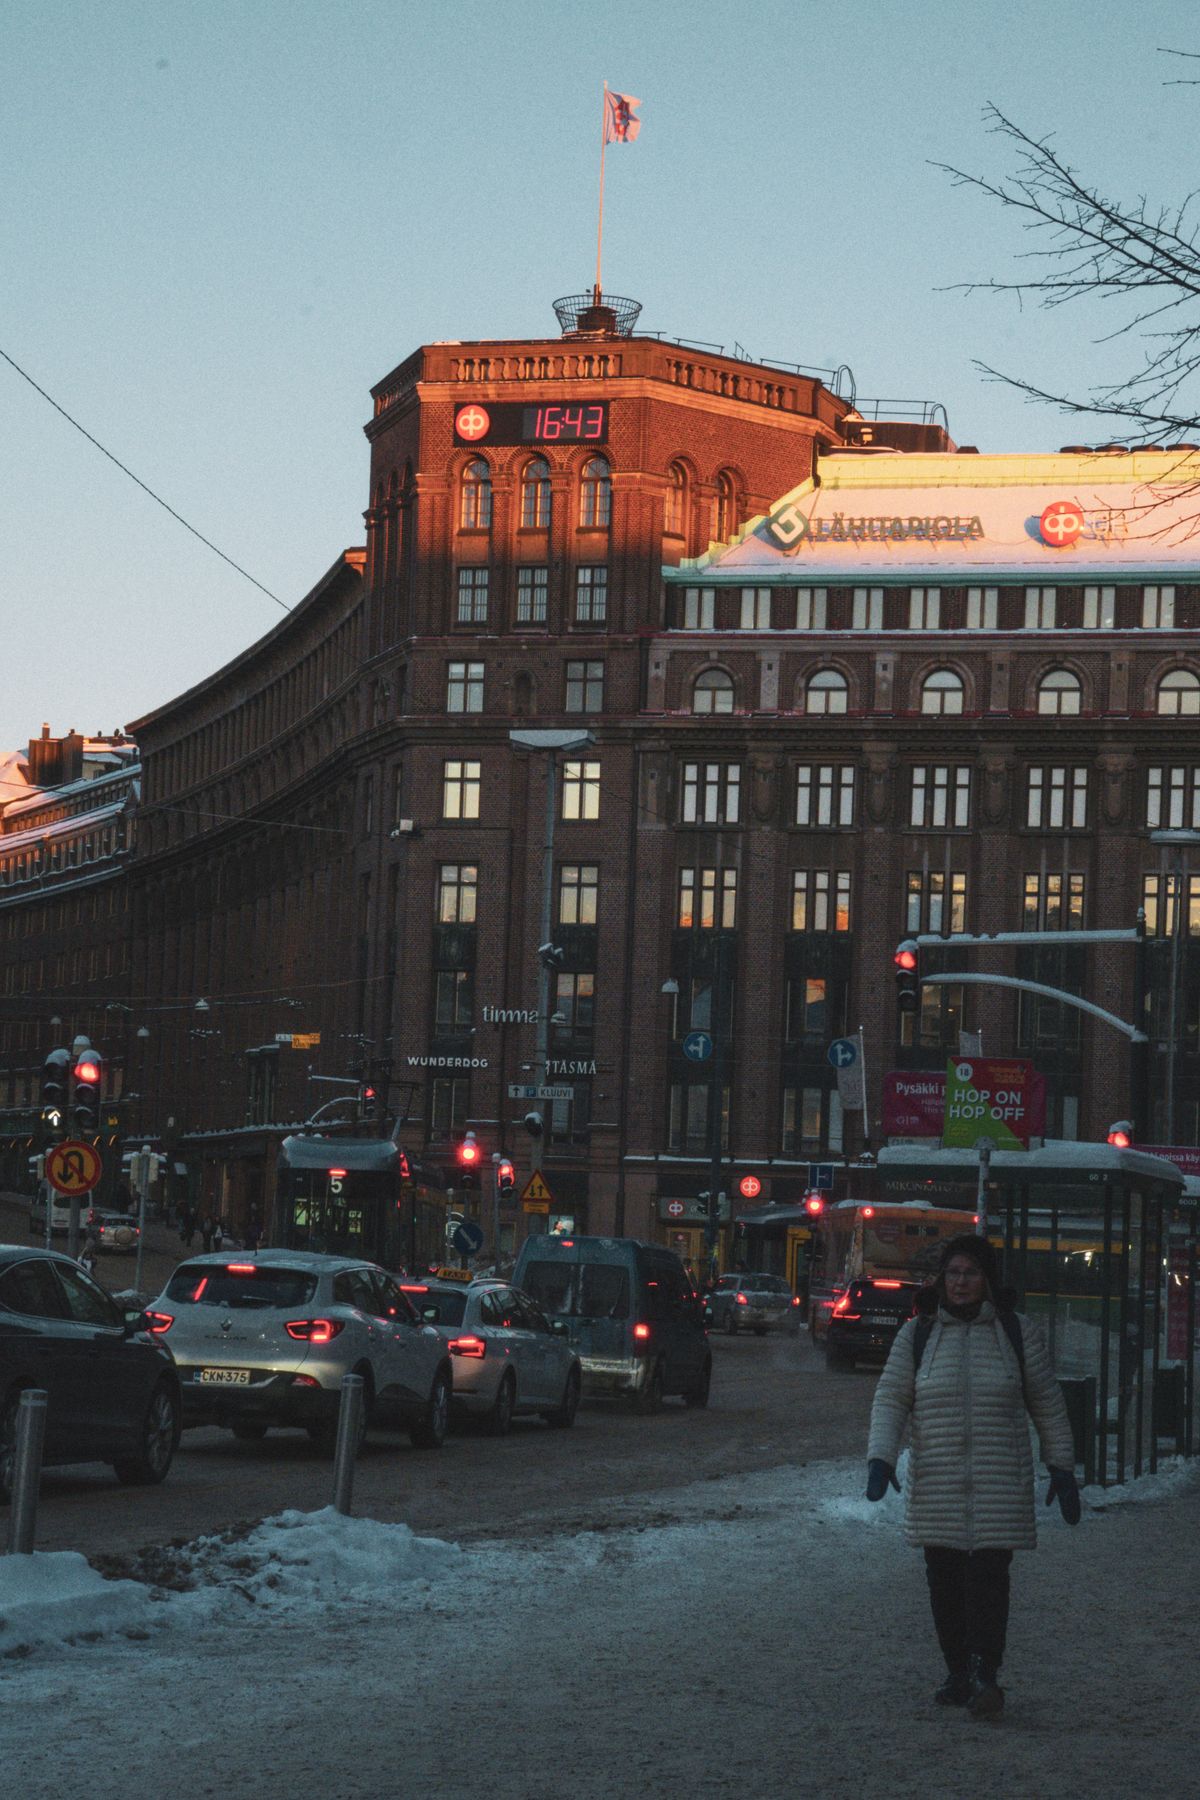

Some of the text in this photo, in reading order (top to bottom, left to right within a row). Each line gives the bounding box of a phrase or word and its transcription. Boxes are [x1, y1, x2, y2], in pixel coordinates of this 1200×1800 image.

[536, 406, 604, 440] 16:43
[482, 1005, 539, 1024] timma
[407, 1056, 489, 1069] WUNDERDOG
[959, 1067, 970, 1077] 18
[540, 1088, 571, 1098] KLUUVI
[896, 1082, 940, 1097] Pysäkki
[953, 1089, 1022, 1105] HOP ON
[949, 1104, 1025, 1122] HOP OFF
[330, 1176, 344, 1194] 5
[202, 1371, 247, 1384] CKN-375
